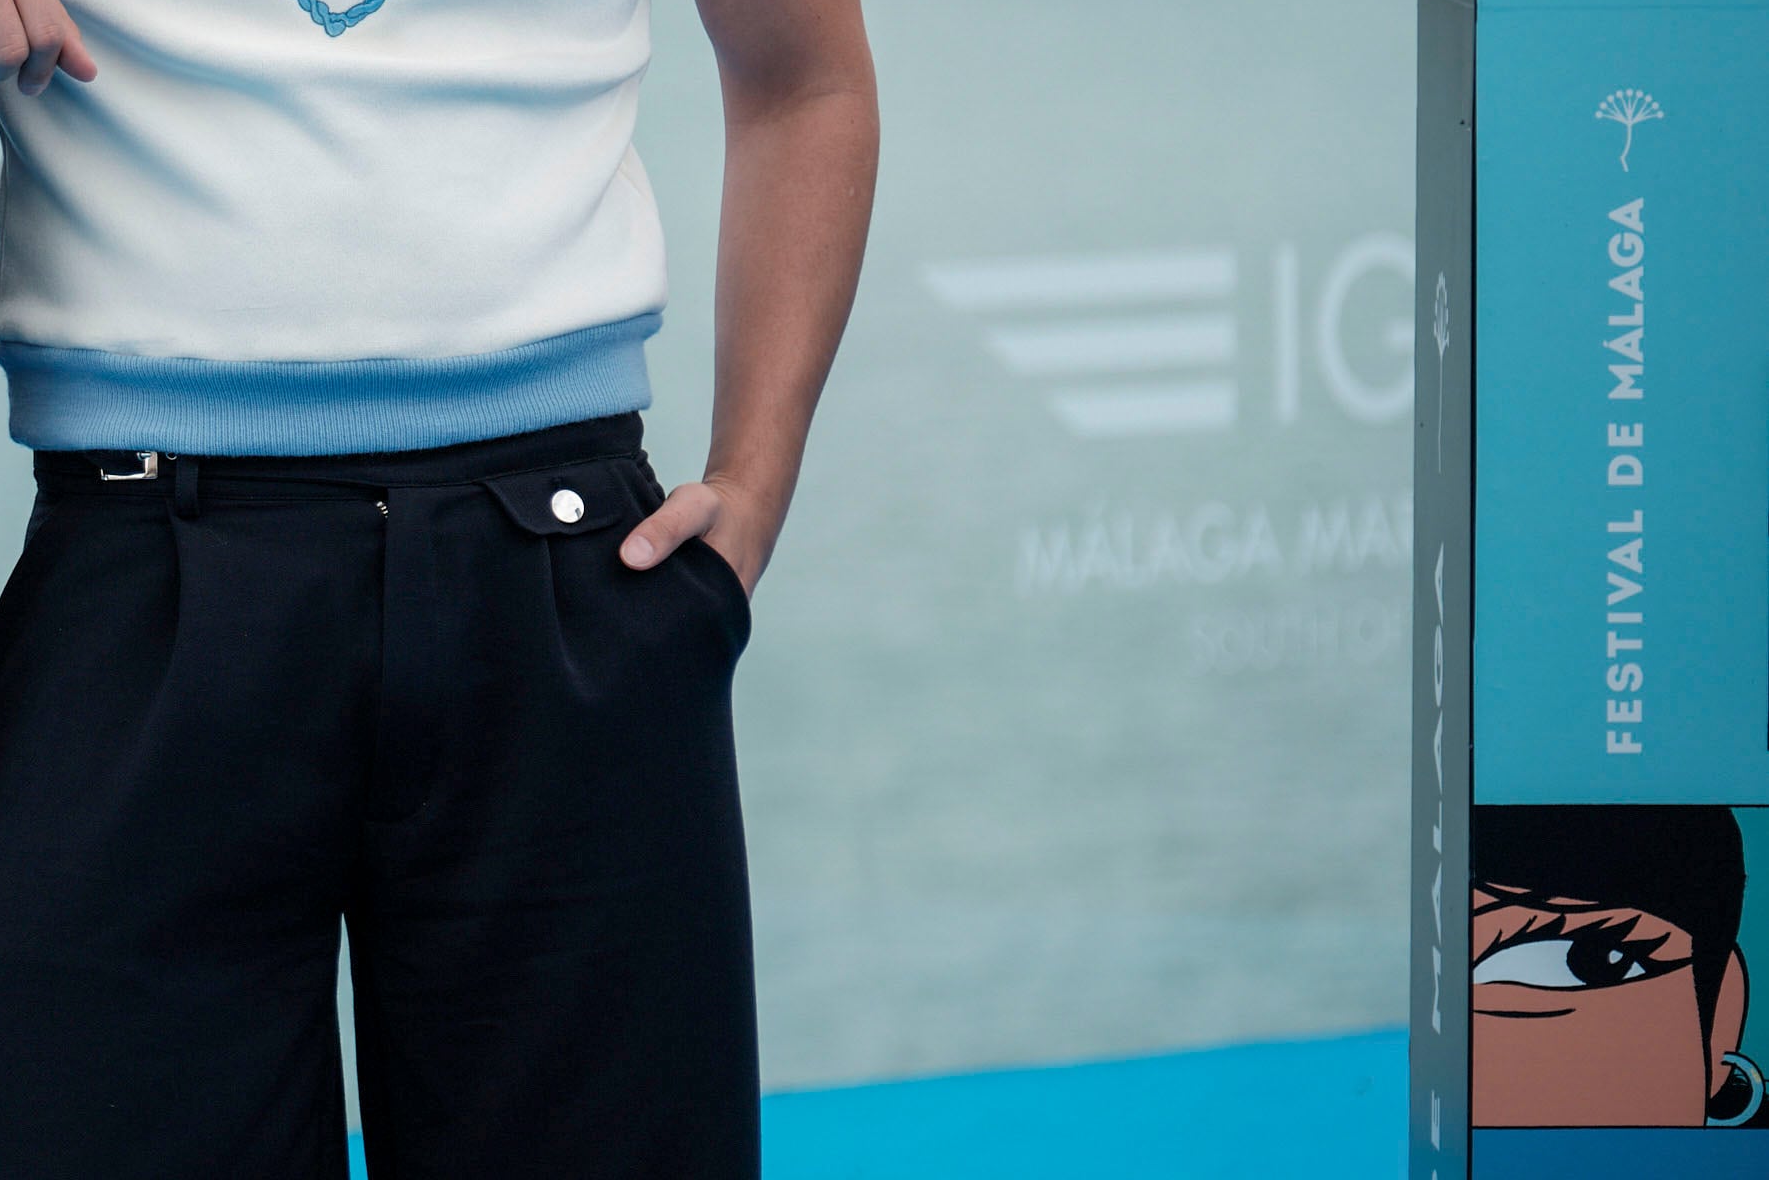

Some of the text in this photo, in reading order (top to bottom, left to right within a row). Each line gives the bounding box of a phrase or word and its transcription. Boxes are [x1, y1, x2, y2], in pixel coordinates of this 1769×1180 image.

[1602, 197, 1645, 754] FESTIVAL DE MÁLAGA
